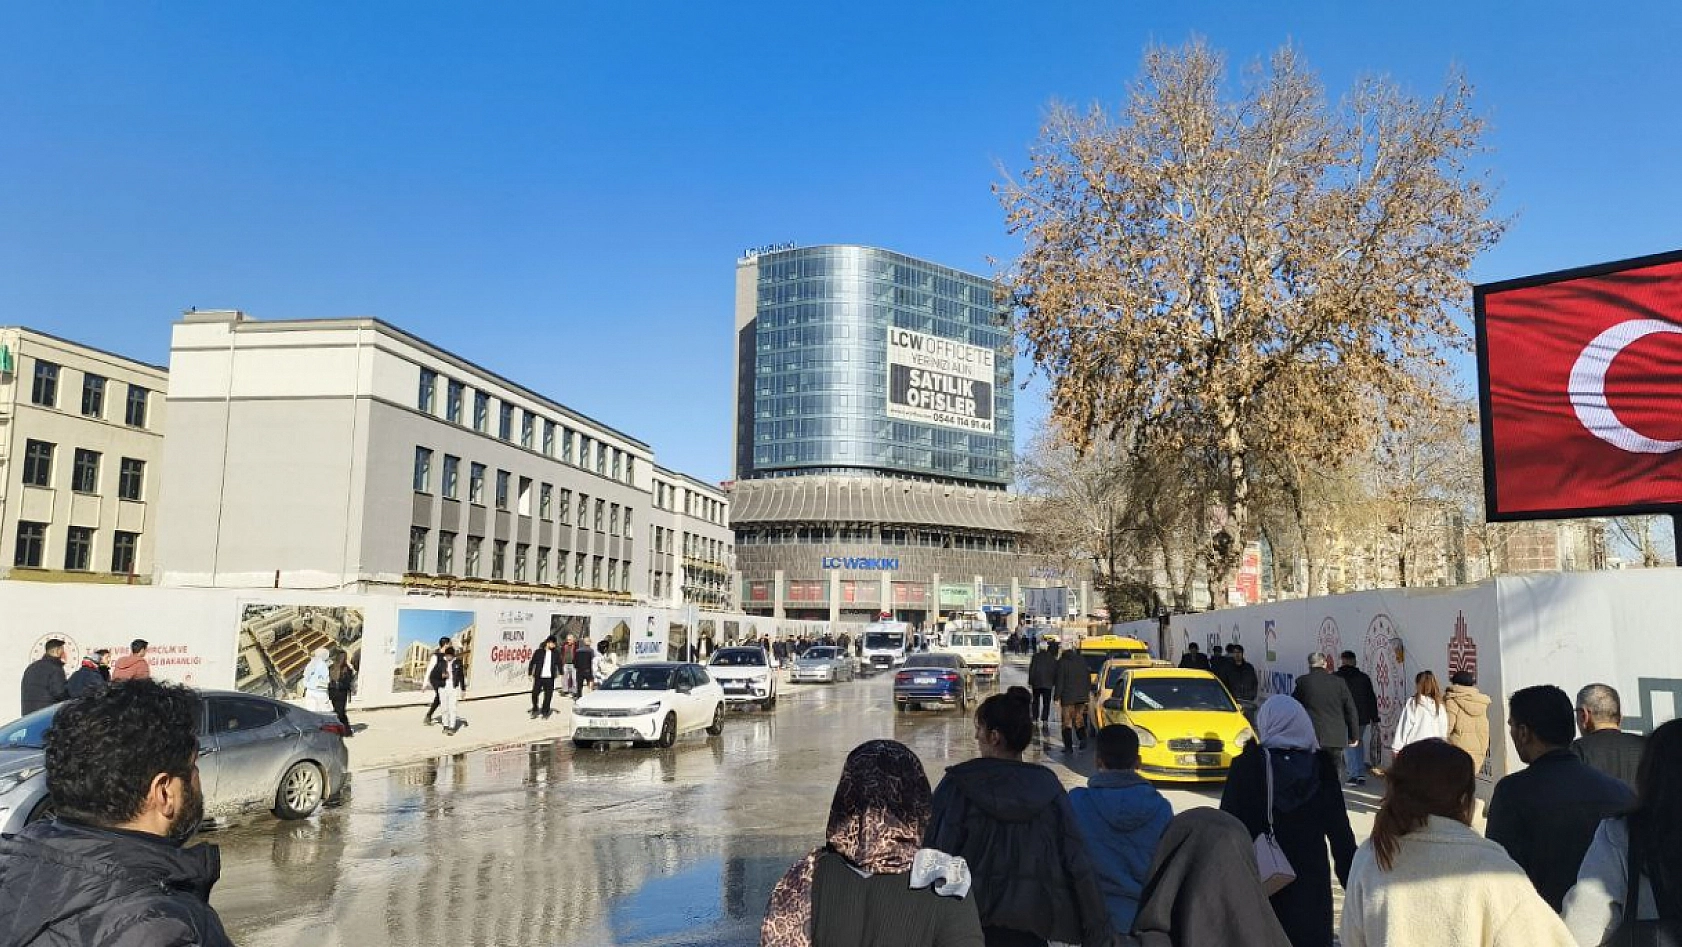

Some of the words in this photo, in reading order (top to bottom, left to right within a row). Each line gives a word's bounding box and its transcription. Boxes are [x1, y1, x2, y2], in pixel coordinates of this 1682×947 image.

[890, 329, 923, 350] LCW
[909, 369, 975, 398] SATILIK
[907, 387, 977, 417] OFİSLER
[933, 413, 955, 424] 0544
[957, 416, 969, 427] 114
[980, 421, 991, 431] 44
[822, 556, 840, 569] LC
[491, 645, 533, 664] Geleceğe
